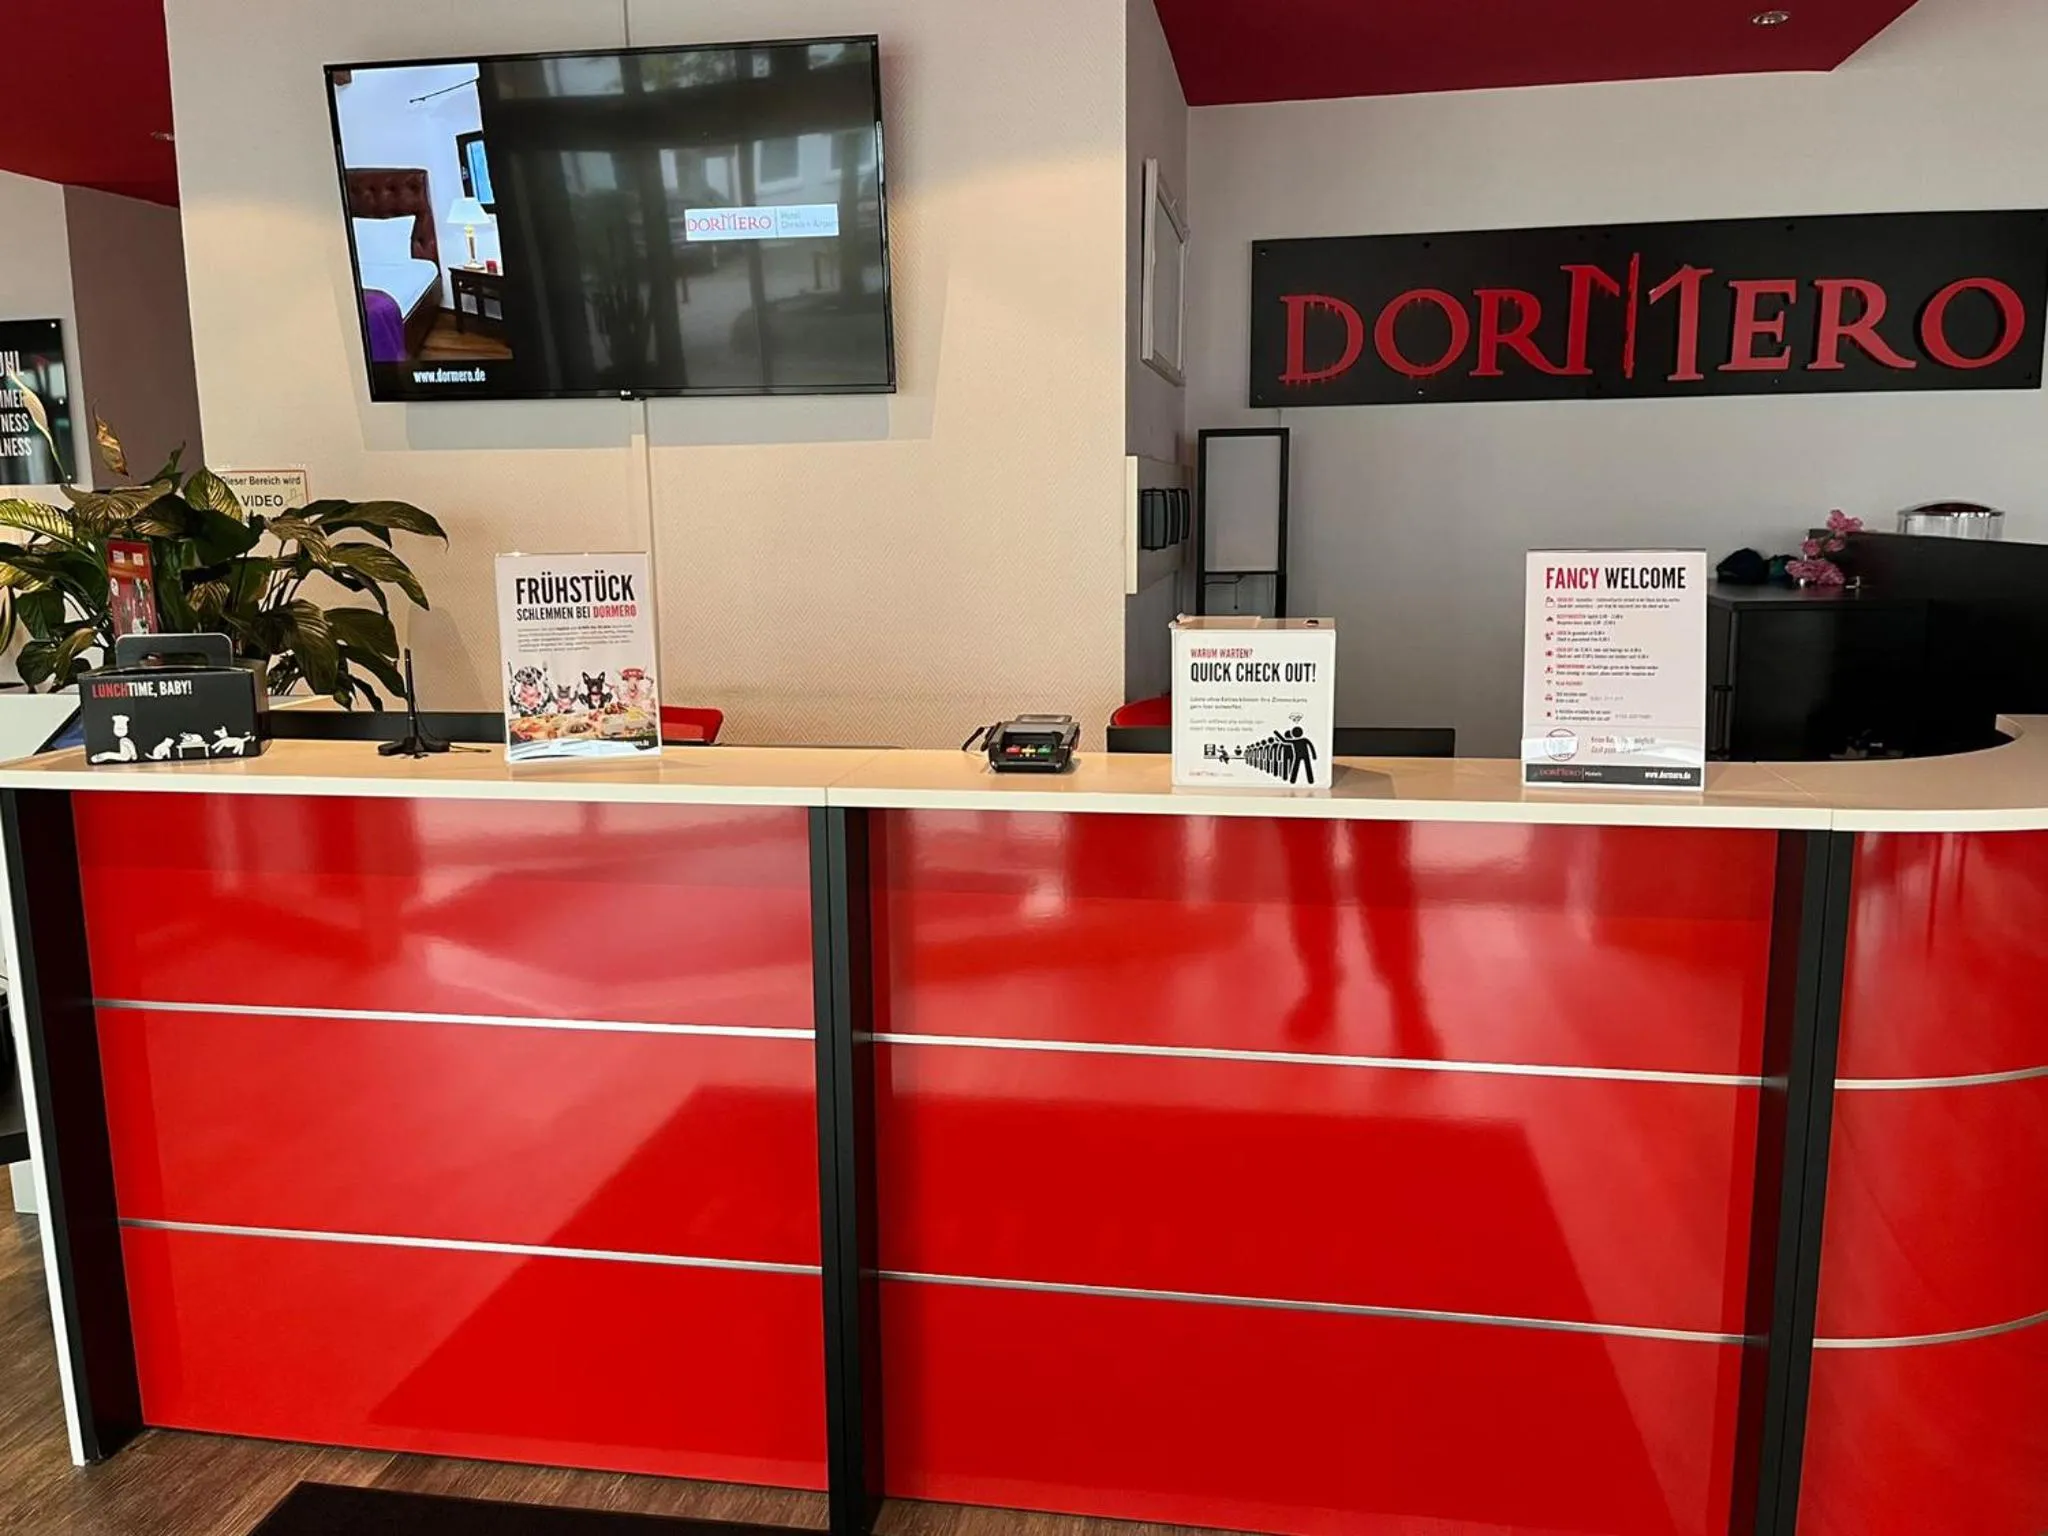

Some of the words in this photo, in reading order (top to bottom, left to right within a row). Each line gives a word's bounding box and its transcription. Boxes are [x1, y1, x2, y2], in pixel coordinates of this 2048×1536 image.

[687, 212, 772, 232] DORMERO
[1278, 252, 2026, 386] DORMERO
[413, 368, 486, 383] www.dormero.de
[0, 413, 30, 432] NESS
[249, 476, 280, 485] Bereich
[283, 476, 301, 485] wird
[241, 495, 284, 507] VIDEO
[515, 569, 636, 604] FRÜHSTÜCK
[1545, 567, 1600, 589] FANCY
[1604, 567, 1687, 589] WELCOME
[516, 606, 574, 621] SCHLEMMEN
[576, 606, 591, 619] BEI
[593, 604, 637, 618] DORMERO
[1190, 648, 1218, 659] WARUM
[1219, 648, 1254, 659] WARTEN?
[1190, 662, 1232, 683] QUICK
[1235, 662, 1281, 683] CHECK
[1284, 662, 1317, 683] OUT!
[91, 681, 158, 698] LUNCHTIME,
[159, 679, 193, 696] BABY!
